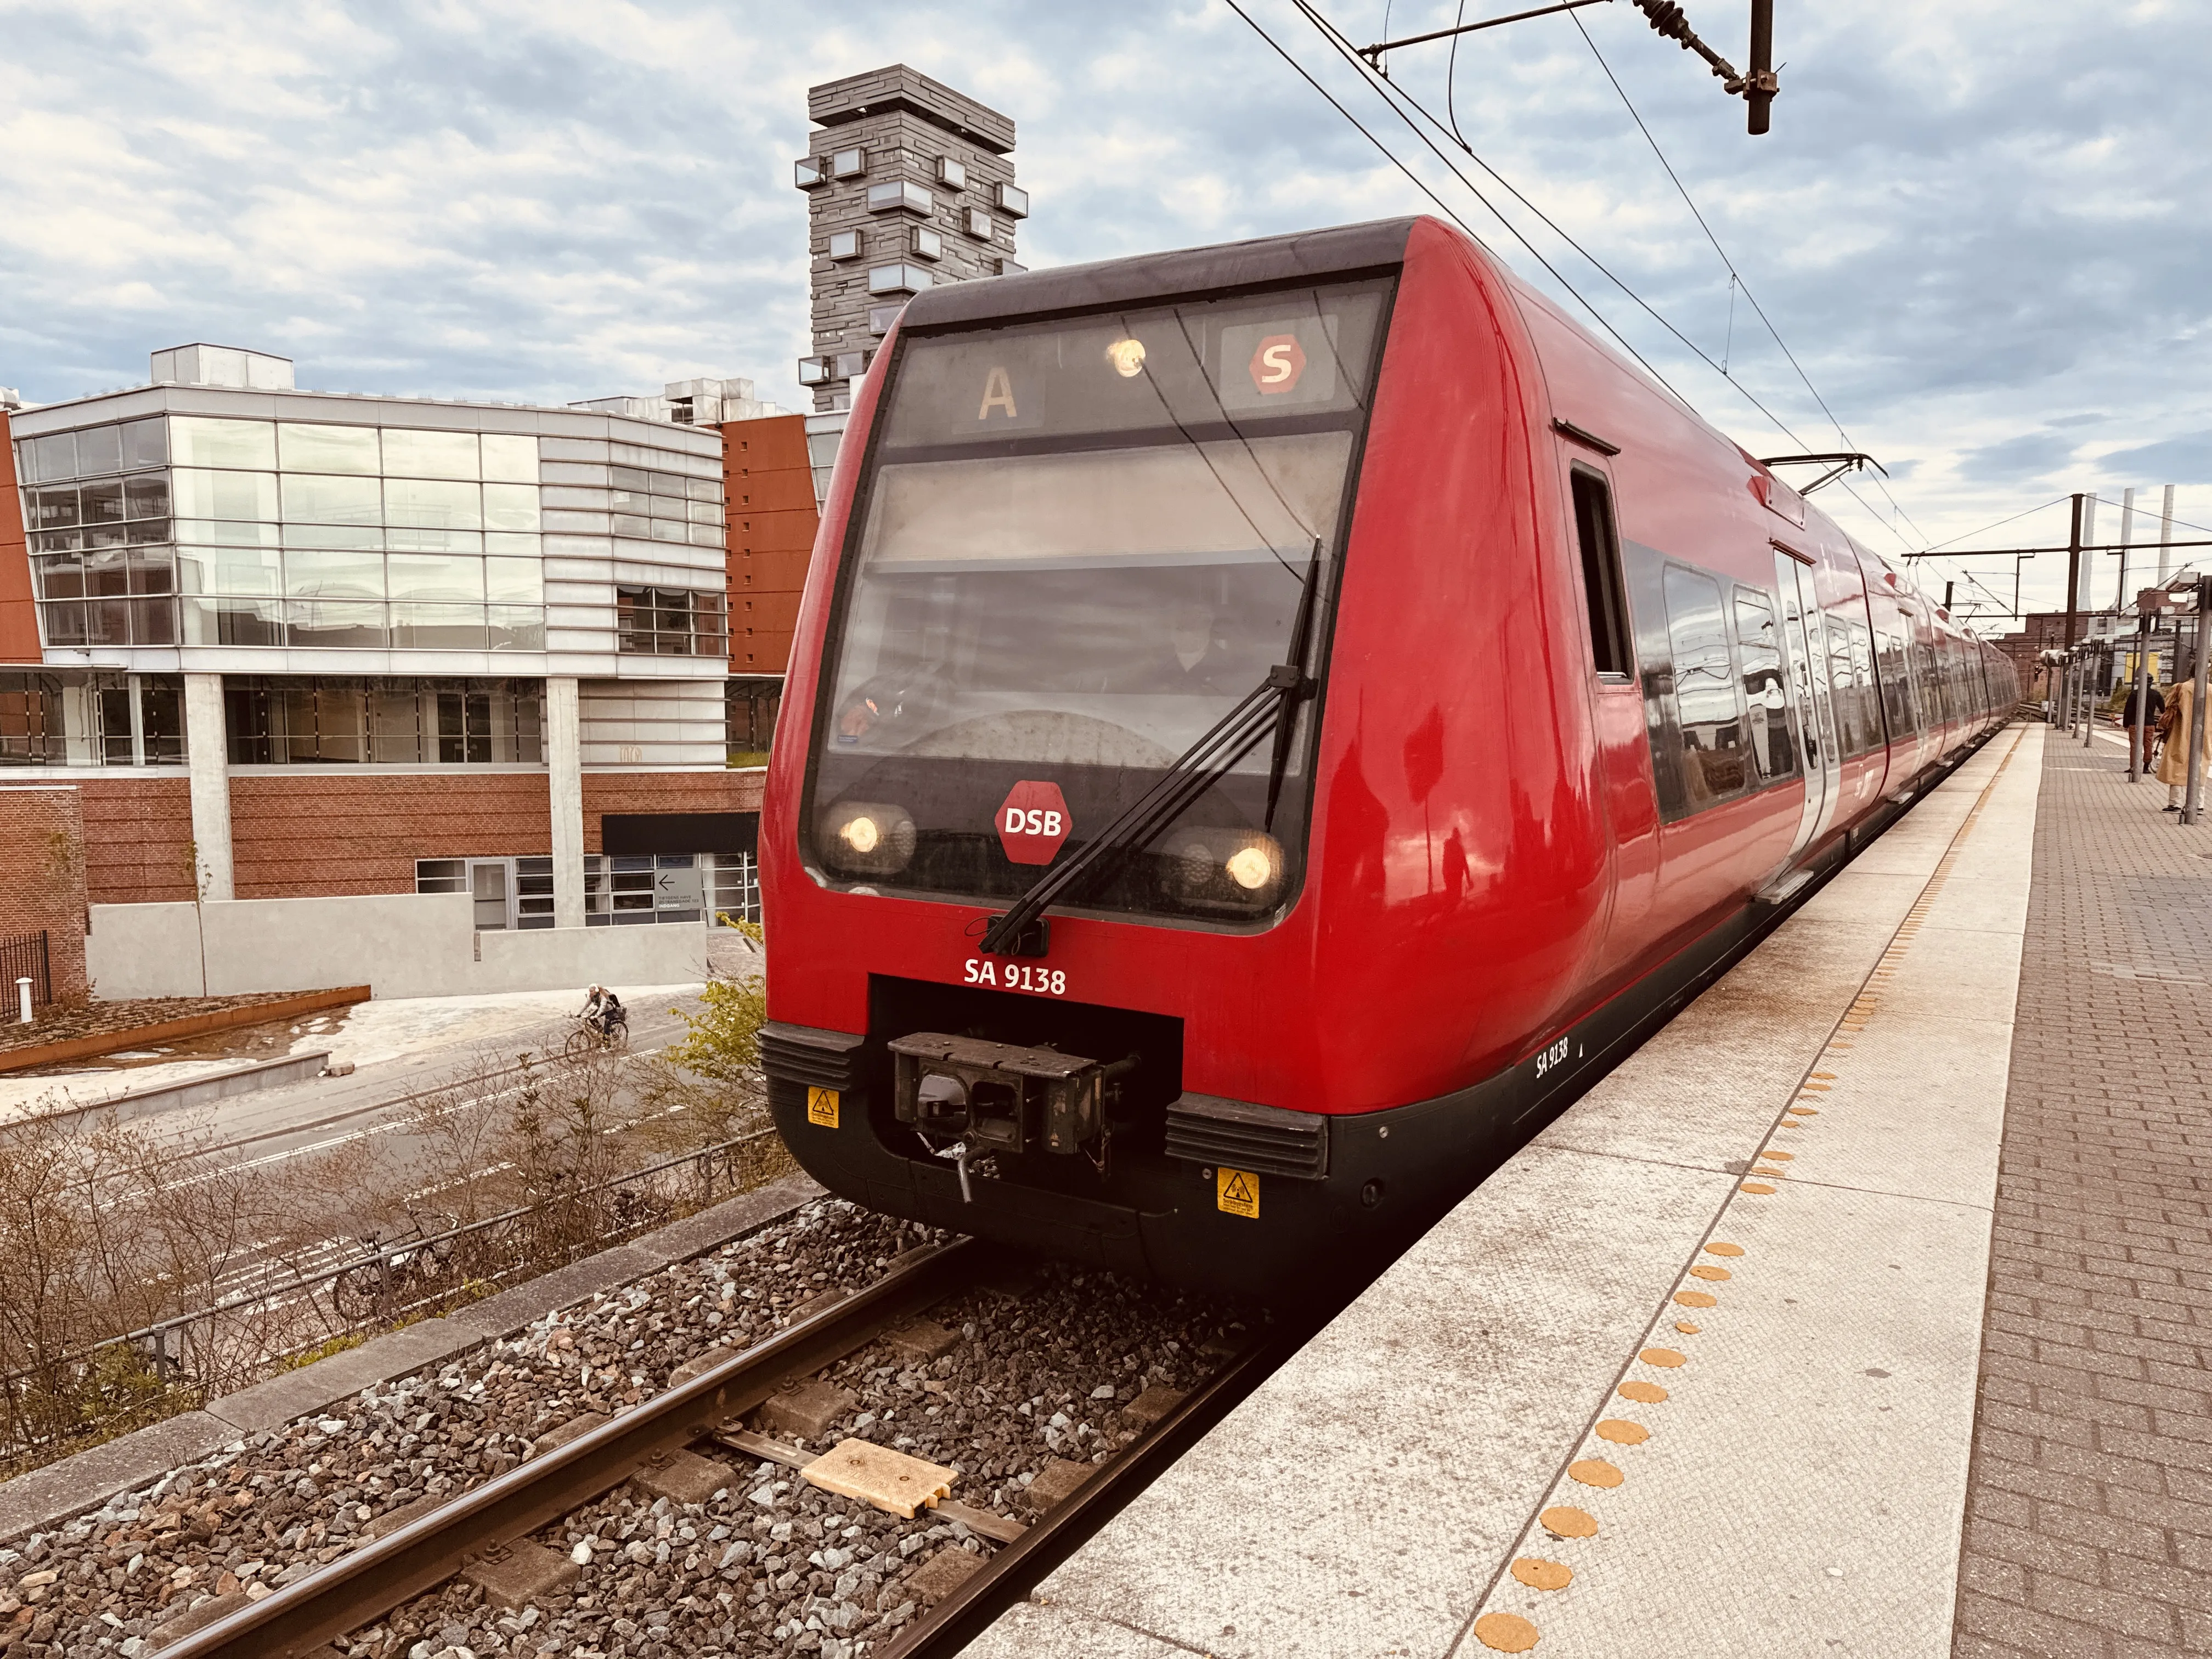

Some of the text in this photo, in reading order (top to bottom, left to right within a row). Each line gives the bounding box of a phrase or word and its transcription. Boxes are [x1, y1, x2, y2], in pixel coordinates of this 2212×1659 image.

[1262, 345, 1291, 383] S
[978, 366, 1017, 420] A
[1005, 808, 1062, 837] DSB
[964, 958, 1066, 995] SA 9138
[1536, 1036, 1568, 1079] SA 9138
